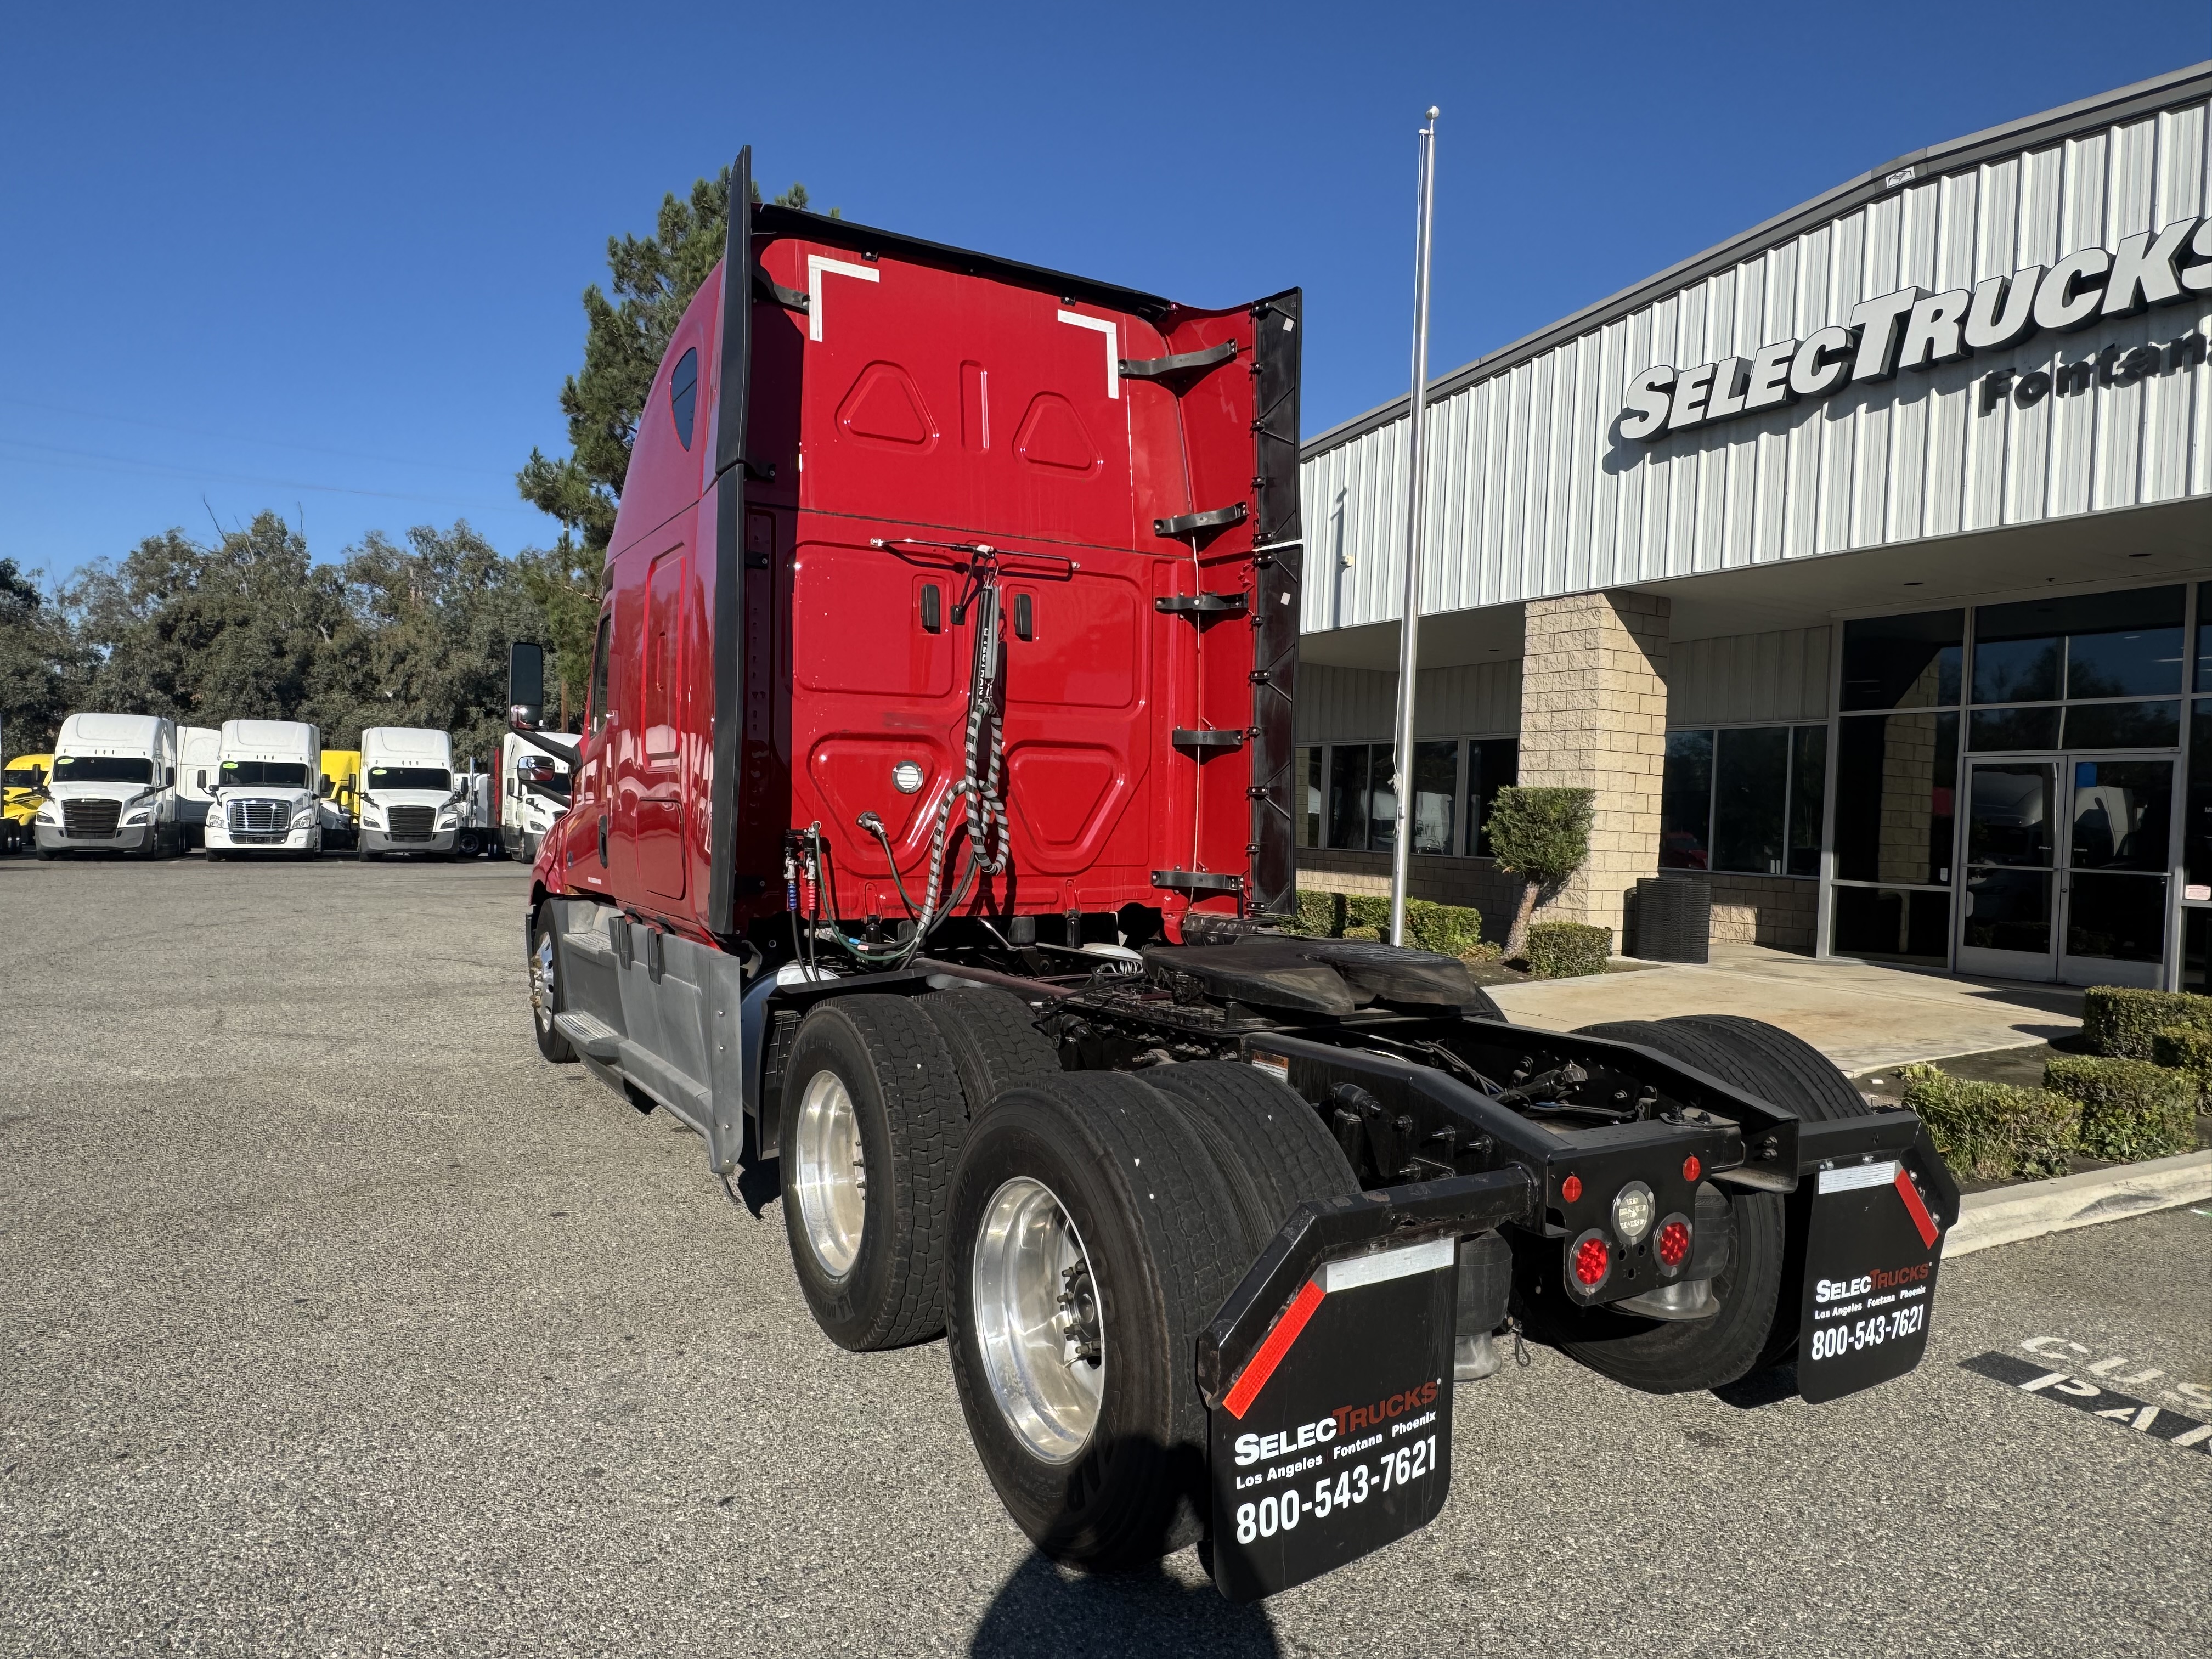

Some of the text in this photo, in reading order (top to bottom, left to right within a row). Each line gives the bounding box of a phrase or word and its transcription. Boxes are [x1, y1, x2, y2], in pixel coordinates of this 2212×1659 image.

[1983, 331, 2212, 411] Fontan
[1814, 1310, 1831, 1320] Los
[1815, 1263, 1929, 1304] SELECTRUCKS
[1812, 1304, 1925, 1361] 800-543-7621
[1234, 1381, 1438, 1466] SELECTRUCKS
[1236, 1410, 1436, 1490] Los Angeles Fontana Phoenix
[1236, 1434, 1436, 1544] 800-543-7621
